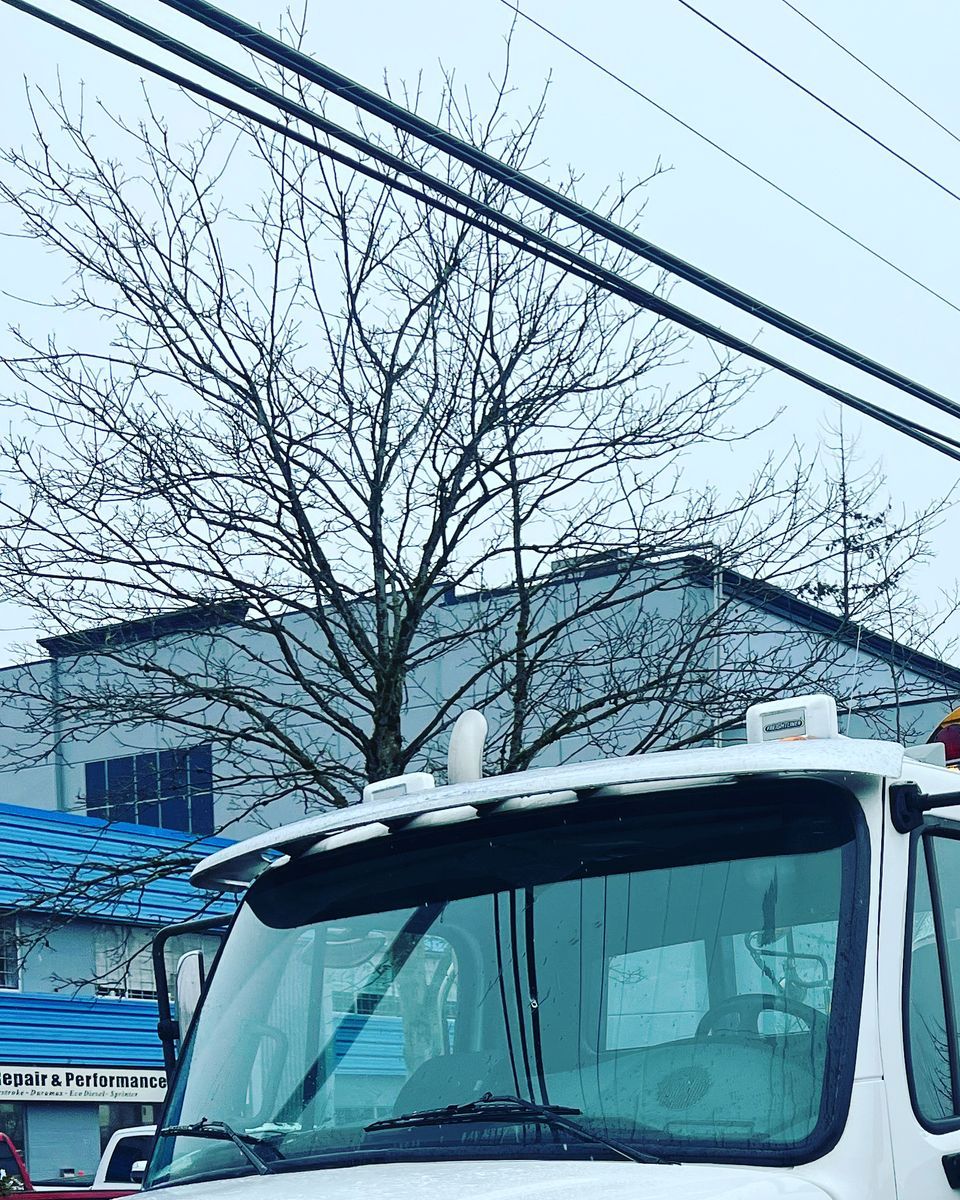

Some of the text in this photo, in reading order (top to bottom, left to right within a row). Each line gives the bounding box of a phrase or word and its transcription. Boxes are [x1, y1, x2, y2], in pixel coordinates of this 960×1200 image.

[0, 1071, 167, 1089] epair & Performance
